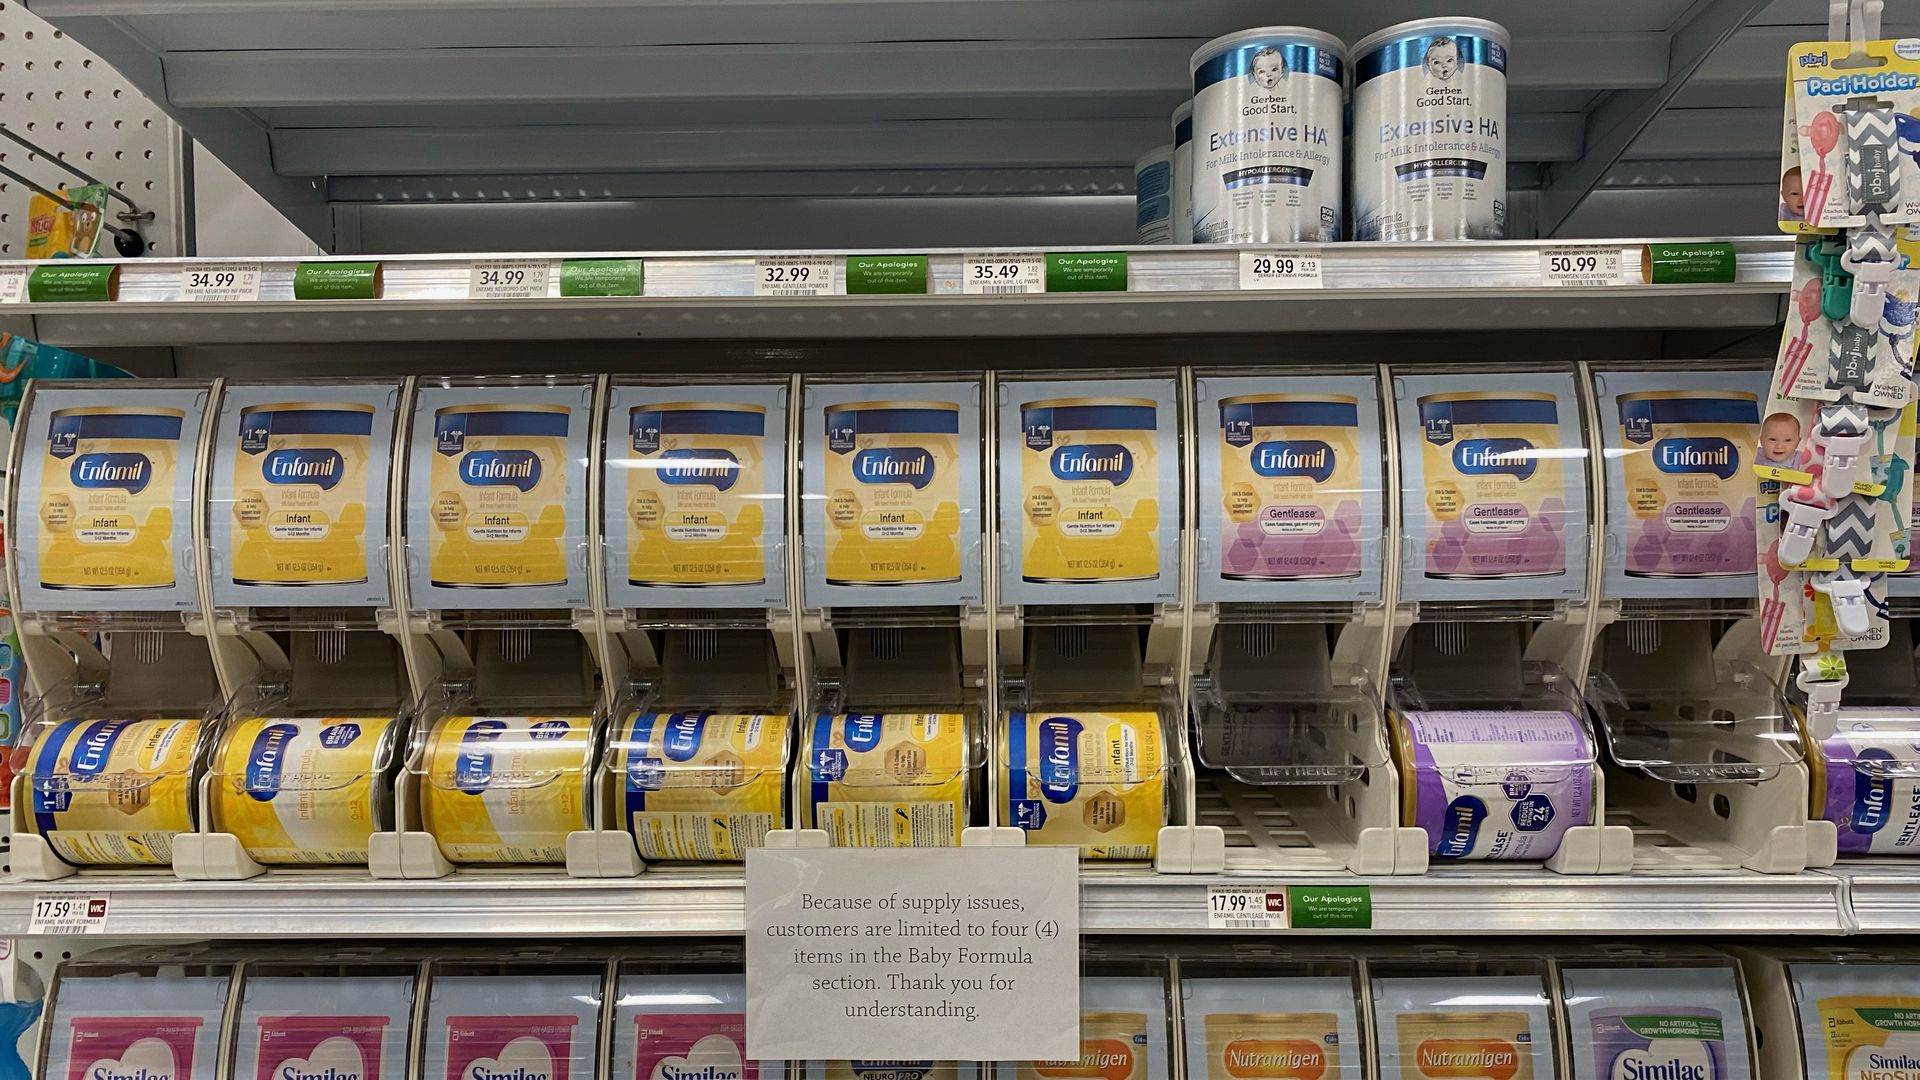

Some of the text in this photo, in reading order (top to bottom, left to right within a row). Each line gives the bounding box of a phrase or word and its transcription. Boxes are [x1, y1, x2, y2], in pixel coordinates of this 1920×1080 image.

[1799, 51, 1828, 67] pbnj
[1809, 73, 1917, 94] Paci Holder
[1416, 96, 1444, 107] Good
[1242, 104, 1268, 116] Good
[1210, 122, 1327, 152] Extensive HA
[1379, 114, 1499, 144] Extensive HA
[1375, 151, 1388, 162] For
[1390, 145, 1411, 158] Milk
[1414, 141, 1470, 152] Intolerance
[1470, 142, 1478, 150] &
[1206, 149, 1330, 171] For Milk Intolerance & Allergy
[1239, 166, 1297, 176] HYPOALLERGENIC
[1077, 257, 1118, 266] Apologies
[1682, 249, 1725, 258] Apologies
[326, 268, 365, 277] Apologies
[590, 265, 631, 275] Apologies
[877, 261, 918, 270] Apologies
[974, 265, 1019, 279] 35.49
[1253, 259, 1294, 274] 29.99
[1551, 257, 1597, 272] 50.99
[41, 270, 100, 280] Our Apologies
[190, 273, 235, 288] 34.99
[479, 270, 525, 285] 34.99
[764, 268, 810, 283] 32.99
[1873, 390, 1903, 400] OWNED
[1059, 453, 1124, 474] Enfamil
[1260, 449, 1326, 470] Enfamil
[1663, 445, 1728, 466] Enfamil
[79, 460, 144, 481] Enfamil
[271, 456, 336, 477] Enfamil
[468, 457, 533, 478] Enfamil
[861, 456, 926, 477] Enfamil
[92, 518, 118, 528] Infant
[286, 513, 312, 524] Infant
[484, 515, 510, 526] Infant
[682, 514, 708, 525] Infant
[879, 513, 905, 523] Infant
[1077, 510, 1103, 521] Infant
[1048, 722, 1069, 792] Enfamil
[1533, 806, 1545, 822] 24
[1442, 806, 1473, 856] Enfamil
[801, 892, 1026, 914] Because of supply issues,
[1211, 895, 1282, 911] 17.99 1.45 WIC
[1302, 895, 1362, 905] Our Apologies
[36, 901, 70, 918] 17.59
[90, 905, 104, 913] WIC
[766, 919, 1060, 940] customers are limited to four (4)
[793, 946, 1033, 968] items in the Baby Formula
[812, 973, 1015, 994] section. Thank you for
[845, 1000, 980, 1022] understanding.
[1640, 1027, 1668, 1035] GROWTH
[1668, 1027, 1700, 1035] HORMONES
[1229, 1049, 1320, 1069] Nutramigen
[1422, 1046, 1513, 1068] Nutramigen
[1623, 1057, 1704, 1080] Similac
